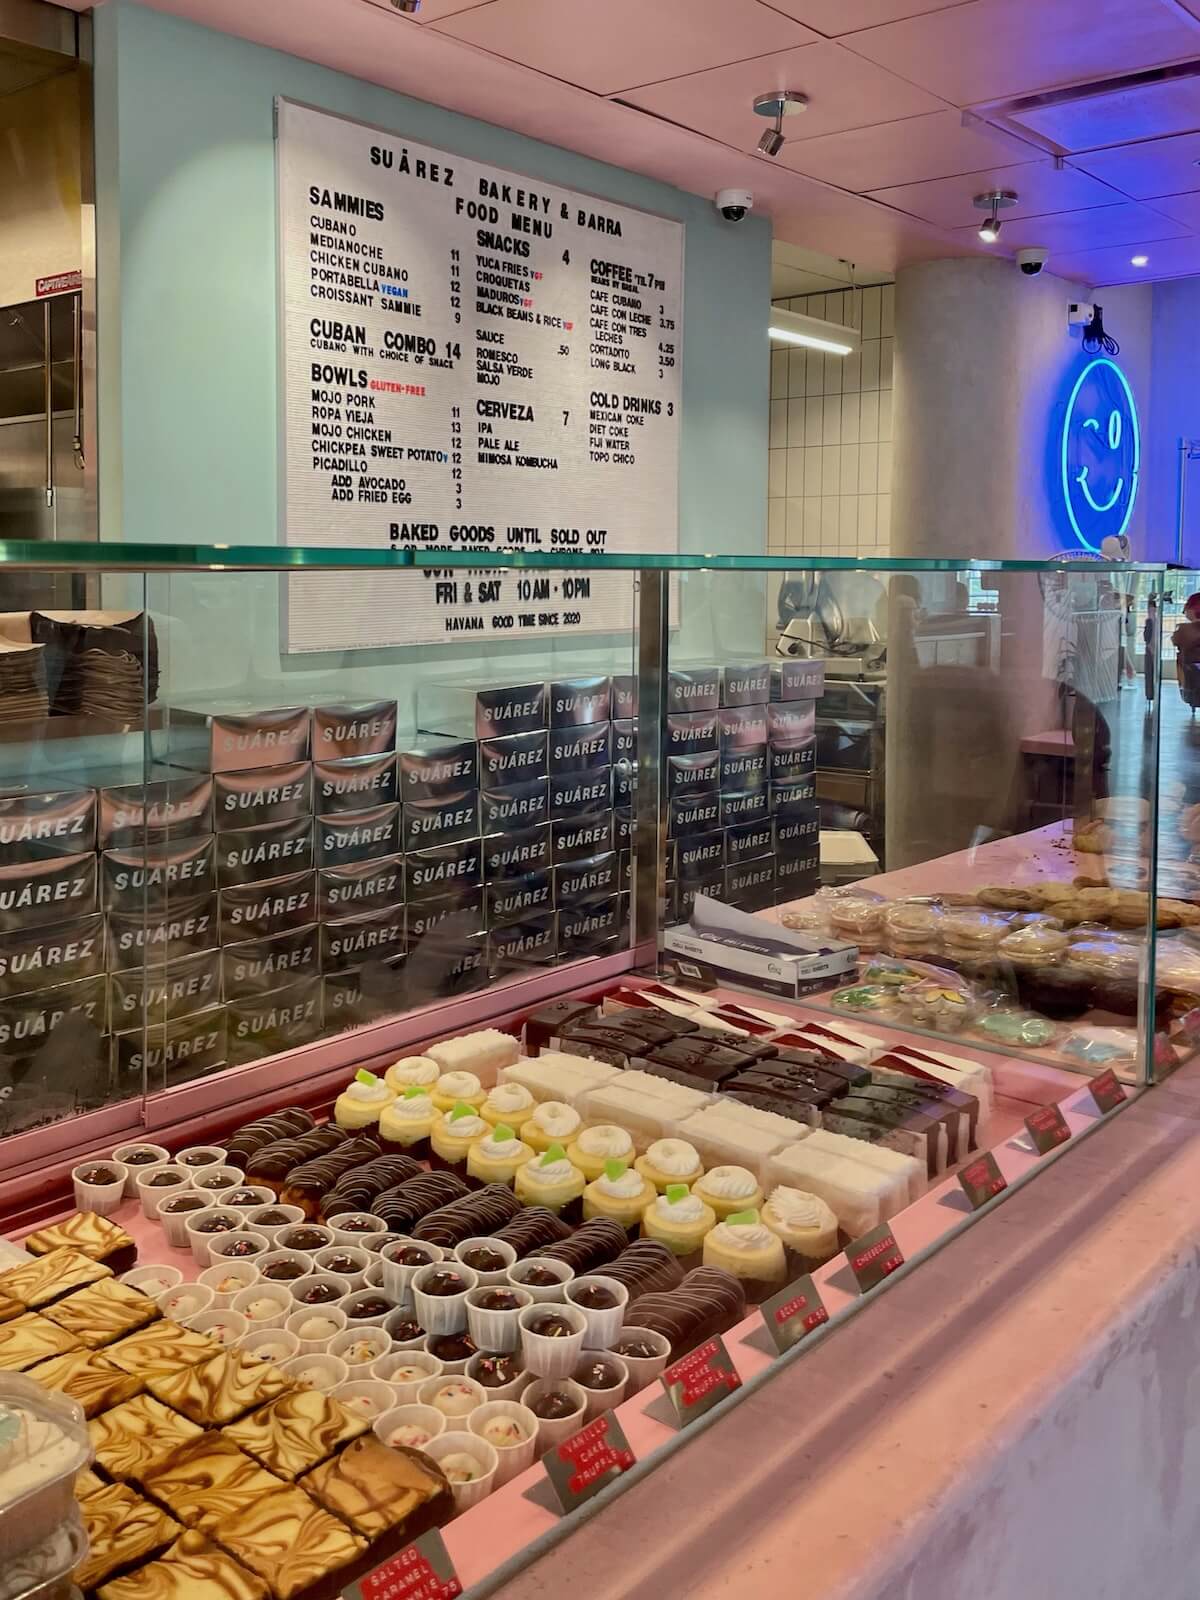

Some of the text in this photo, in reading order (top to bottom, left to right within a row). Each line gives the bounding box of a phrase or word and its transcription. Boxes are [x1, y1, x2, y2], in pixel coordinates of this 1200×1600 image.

[309, 186, 384, 221] SAMMIES
[479, 178, 550, 213] BAKERY
[560, 202, 569, 219] &
[577, 210, 622, 237] BARRA
[455, 197, 552, 238] FOOD MENU
[310, 215, 459, 261] CUBANO 11
[476, 230, 570, 265] SNACKS 4
[310, 233, 459, 277] MEDIANOCHE 11
[476, 254, 500, 271] YUCA
[502, 262, 529, 277] FRIES
[310, 251, 460, 293] CHICKEN CUBANO 12
[476, 271, 531, 292] CROQUETAS
[590, 259, 632, 283] COFFEE
[647, 273, 655, 288] 7
[311, 268, 460, 308] PORTABELLA VEGAN 12
[477, 286, 520, 304] MADUROS
[310, 284, 461, 324] CROISSANT SAMMIE 9
[590, 289, 664, 315] CAFE CUBANO 3
[476, 301, 504, 317] BLACK
[506, 306, 534, 323] BEANS
[535, 313, 542, 324] &
[543, 316, 562, 329] RICE
[591, 304, 675, 330] CAFE CON LECHE 3.75
[310, 318, 461, 360] CUBAN COMBO 14
[476, 329, 504, 344] SAUCE
[590, 318, 647, 338] CAFE CON TRES
[310, 339, 454, 369] CUBANO WITH CHOICE OF SNACK
[595, 330, 675, 354] LECHES 4.25
[476, 347, 518, 364] ROMESCO
[590, 343, 675, 367] CORTADITO 3.50
[311, 363, 426, 396] BOWLS GLUTEN-FREE
[476, 360, 533, 379] SALSA VERDE
[477, 372, 500, 386] MOJO
[591, 358, 664, 379] LONG BLACK 3
[312, 389, 460, 418] MOJO PORK 11
[476, 399, 569, 426] CERVEZA 7
[590, 391, 674, 416] COLD DRINKS 3
[312, 406, 461, 433] ROPA VIEJA 13
[478, 422, 493, 434] IPA
[589, 423, 629, 437] DIET COKE
[590, 410, 645, 426] MEXICAN COKE
[312, 423, 462, 449] MOJO CHICKEN 12
[478, 437, 520, 452] PALE ALE
[590, 437, 630, 451] FIJI WATER
[312, 440, 366, 456] CHICKPEA
[371, 445, 404, 459] SWEET
[407, 449, 443, 462] POTATO
[452, 452, 462, 464] 12
[478, 452, 558, 469] MIMOSA KOMBUCHA
[589, 451, 635, 465] TOPO CHICO
[313, 457, 462, 479] PICADILLO 12
[331, 474, 462, 494] ADD AVOCADO 3
[332, 488, 462, 509] ADD FRIED EGG 3
[390, 523, 607, 545] BAKED GOODS UNTIL SOLD OUT
[436, 582, 457, 604] FRI
[464, 582, 473, 603] &
[478, 580, 502, 603] SAT
[445, 611, 581, 631] HAVANA GOOD TIME SINCE 2020
[675, 684, 716, 699] SUÁREZ
[730, 678, 767, 693] SUÁREZ
[483, 700, 540, 722] SUÁREZ
[322, 720, 392, 743] SUÁREZ
[554, 739, 606, 760] SUÁREZ
[774, 750, 813, 767] SUÁREZ
[225, 782, 305, 811] SUÁREZ
[555, 783, 607, 806] SUÁREZ
[324, 824, 394, 851] SUÁREZ
[226, 838, 306, 868] SUÁREZ
[115, 859, 207, 891] SUÁREZ
[231, 892, 310, 924] SUÁREZ
[120, 915, 210, 950] SUÁREZ
[237, 999, 315, 1038] SUÁREZ
[671, 1342, 717, 1378] CHOCOLATE
[689, 1364, 710, 1383] CAKE
[566, 1419, 607, 1453] VANILLA
[580, 1440, 605, 1462] CAKE
[577, 1449, 617, 1483] TRUFFLE
[371, 1549, 417, 1586] SALTED
